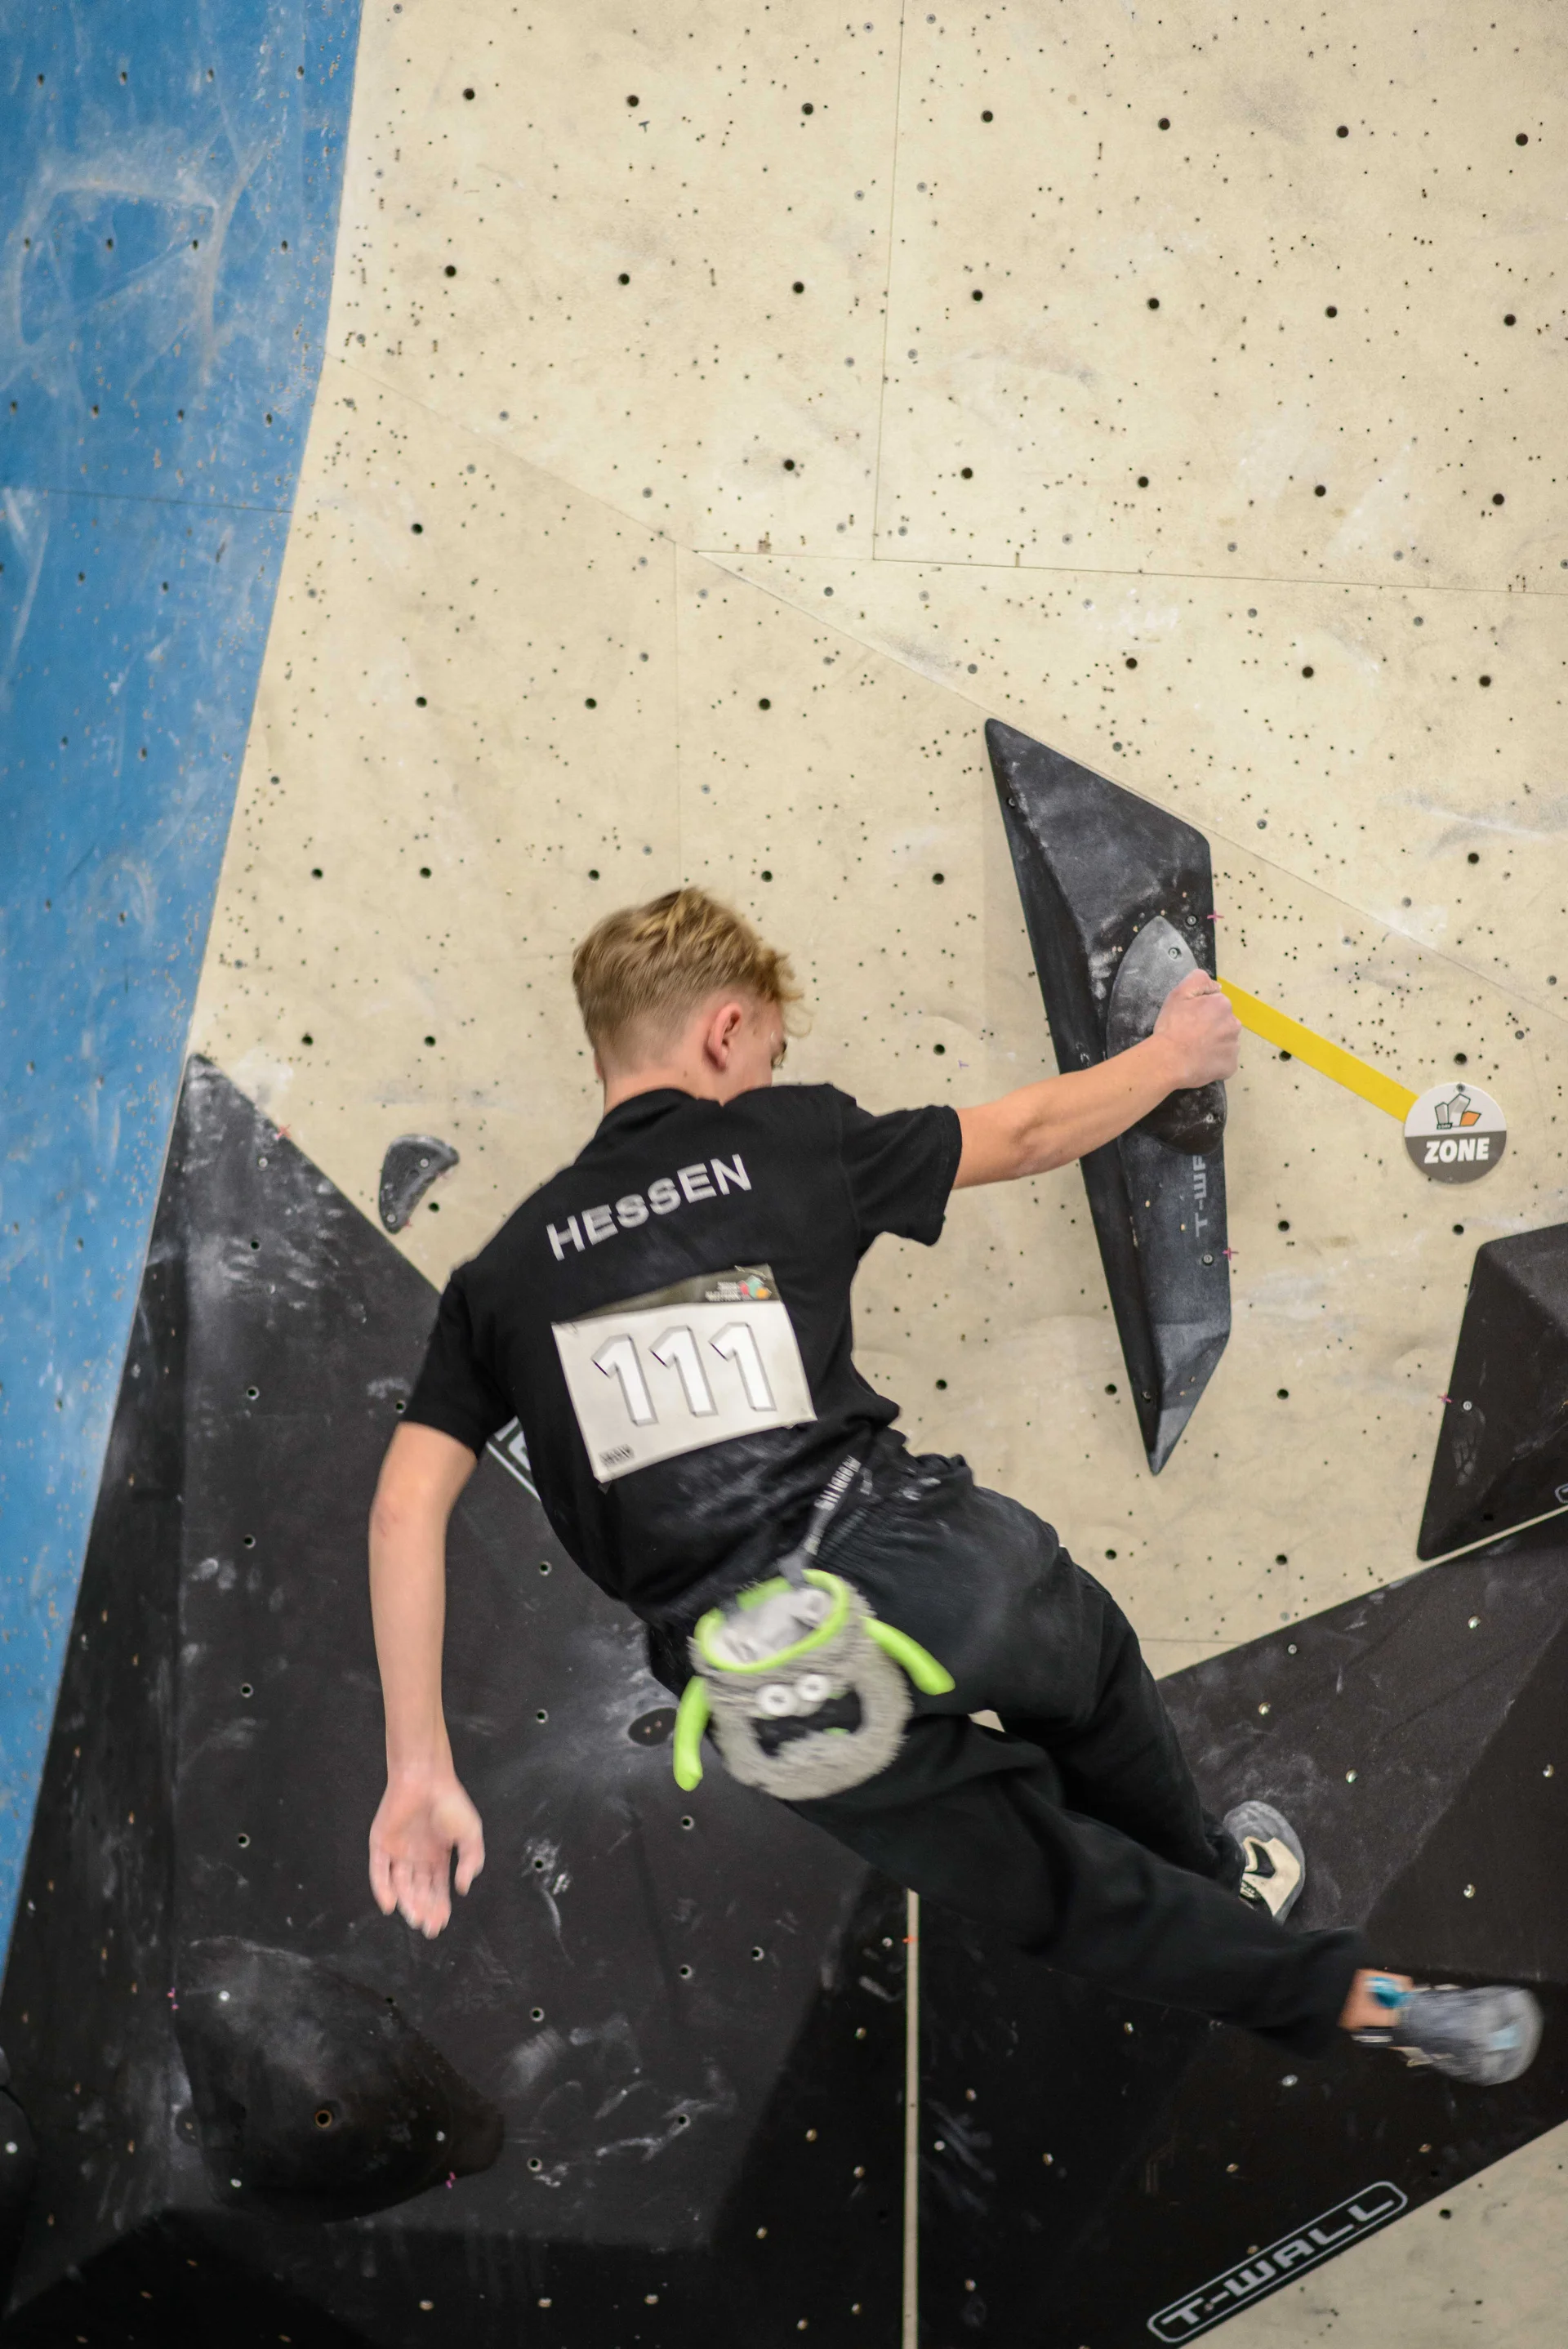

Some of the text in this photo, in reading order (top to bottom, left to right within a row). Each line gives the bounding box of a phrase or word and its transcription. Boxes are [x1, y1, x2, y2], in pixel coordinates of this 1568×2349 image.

[1423, 1137, 1490, 1164] ZONE
[546, 1153, 752, 1261] HESSEN
[590, 1322, 778, 1428] 111
[1160, 2200, 1395, 2324] T-WALL
